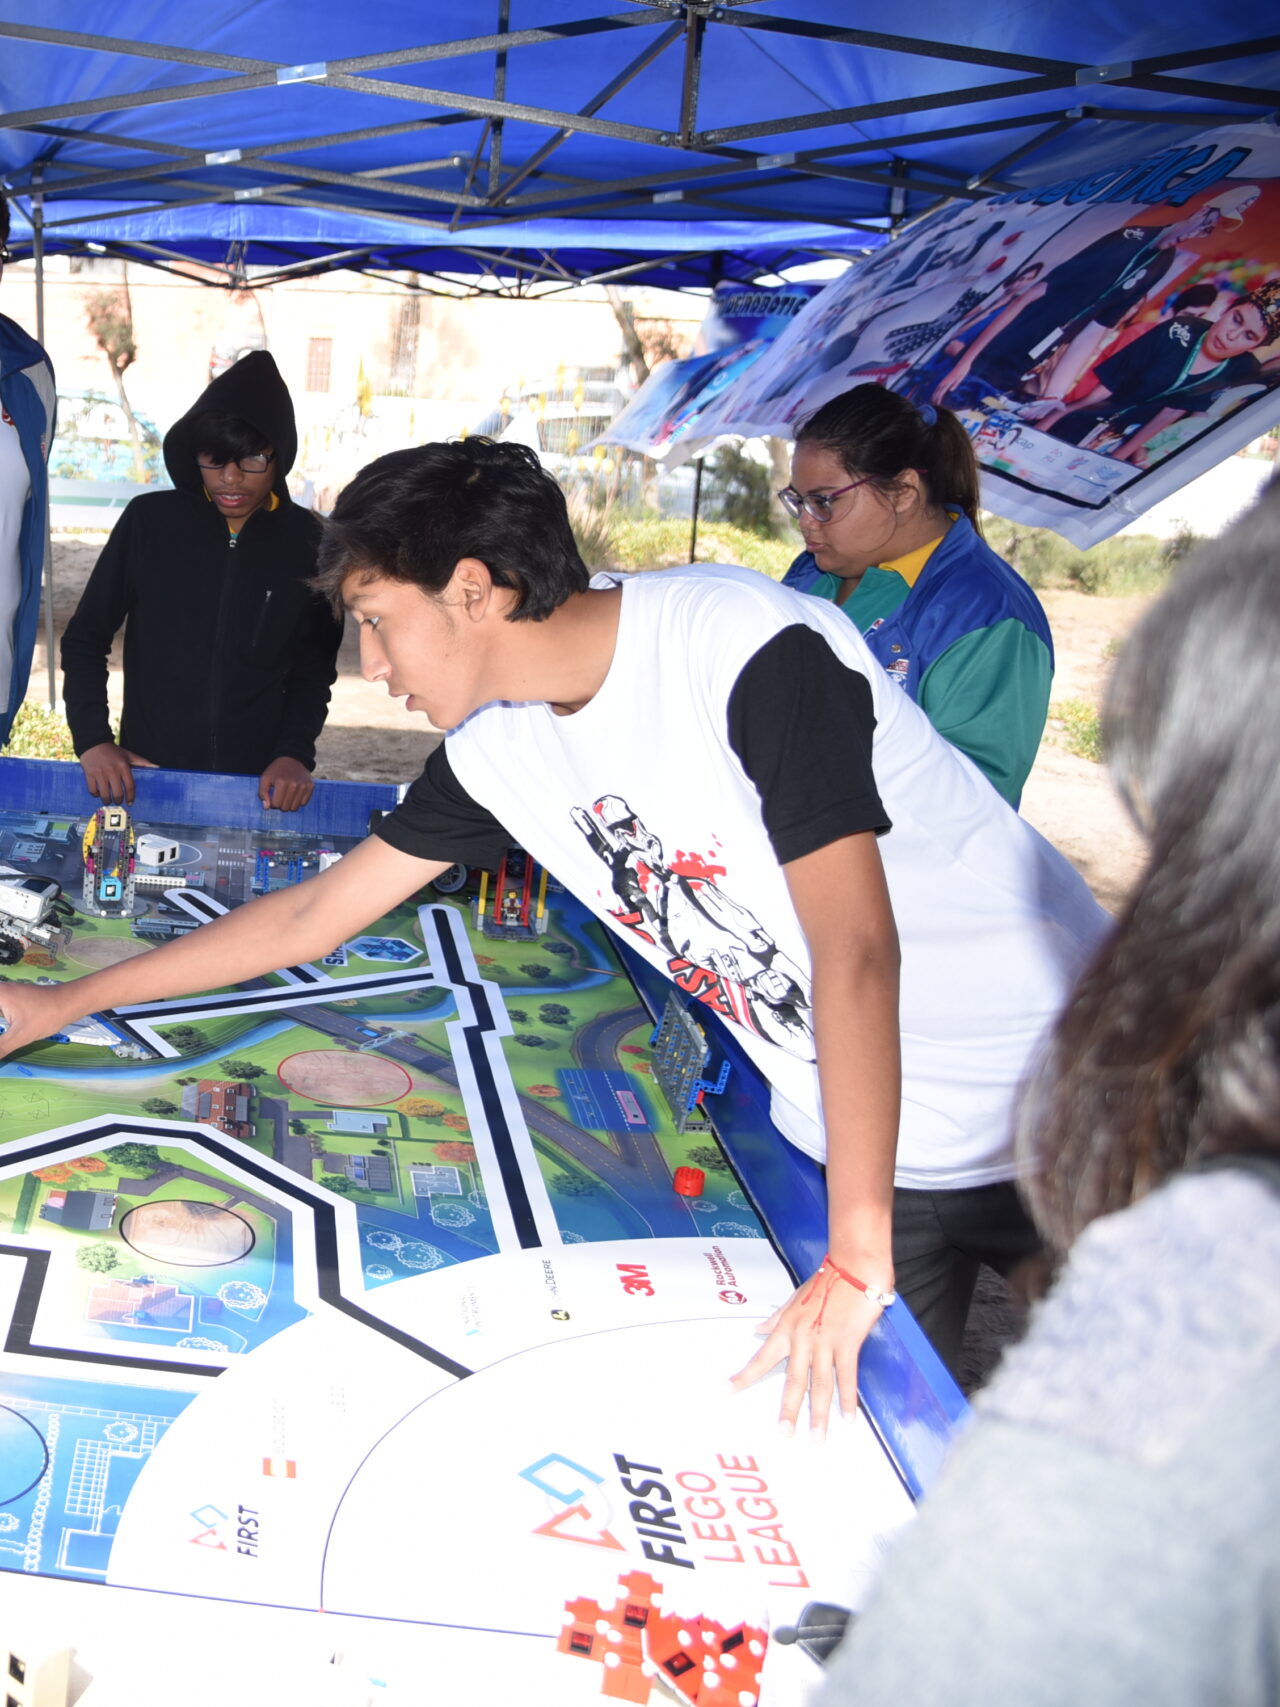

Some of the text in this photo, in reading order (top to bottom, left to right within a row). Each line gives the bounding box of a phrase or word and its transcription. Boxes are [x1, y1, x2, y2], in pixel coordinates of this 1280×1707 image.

[541, 1259, 556, 1285] DEERE
[616, 1263, 656, 1297] 3M
[703, 1252, 726, 1286] Rockwell
[712, 1245, 738, 1287] Automation
[237, 1504, 259, 1558] FIRST
[612, 1452, 696, 1570] FIRST
[674, 1471, 745, 1563] LEGO
[716, 1453, 811, 1588] LEAGUE
